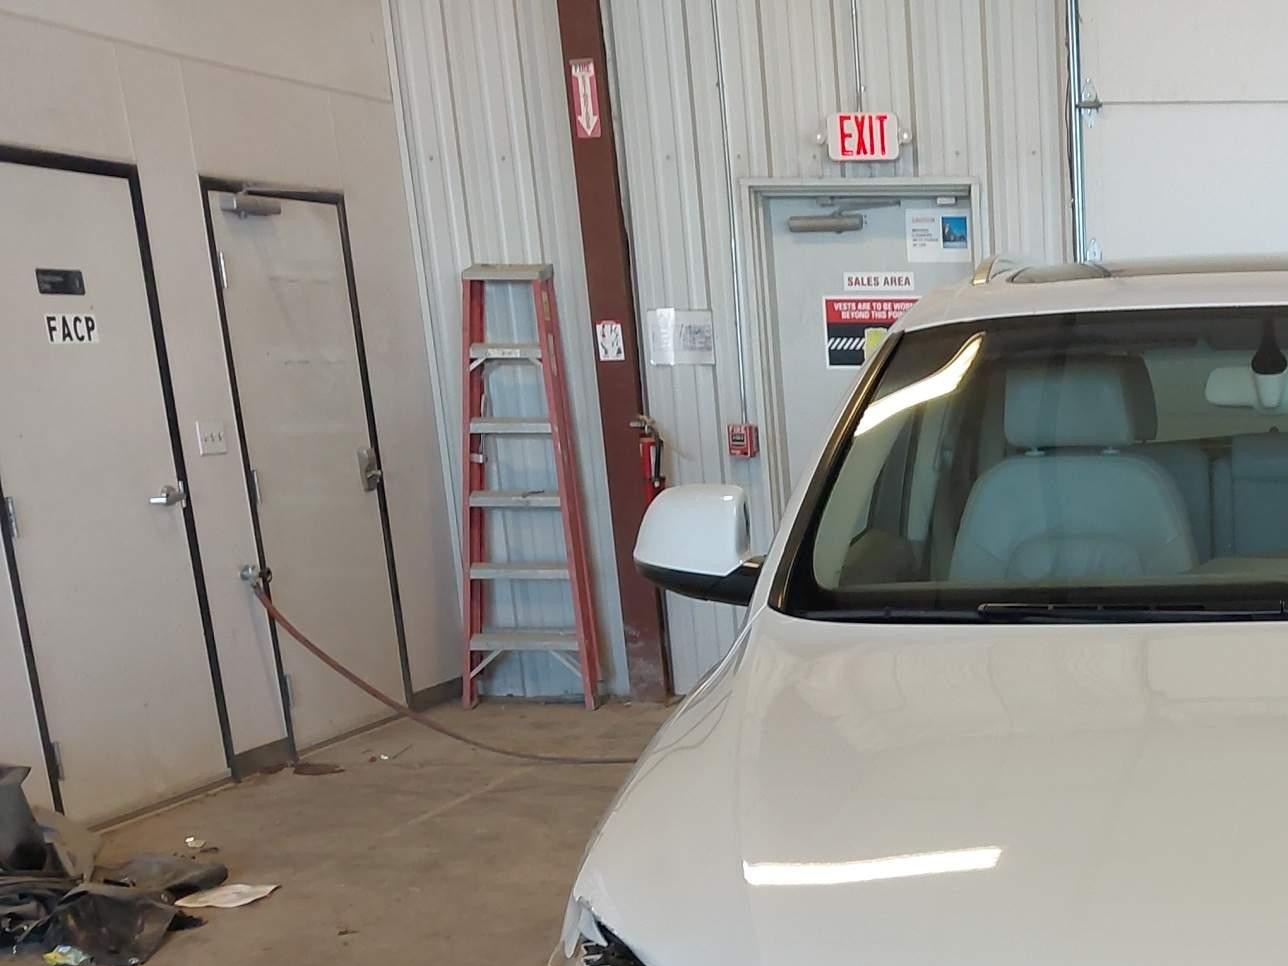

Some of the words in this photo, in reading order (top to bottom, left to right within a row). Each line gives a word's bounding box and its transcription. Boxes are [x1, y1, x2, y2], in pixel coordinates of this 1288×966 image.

[839, 115, 888, 156] EXIT
[847, 276, 880, 287] SALES
[883, 276, 911, 287] AREA
[834, 302, 857, 311] VESTS
[857, 302, 871, 311] ARE
[872, 302, 882, 311] TO
[883, 302, 893, 311] BE
[841, 311, 870, 320] BEYOND
[871, 311, 888, 320] THIS
[46, 315, 96, 342] FACP
